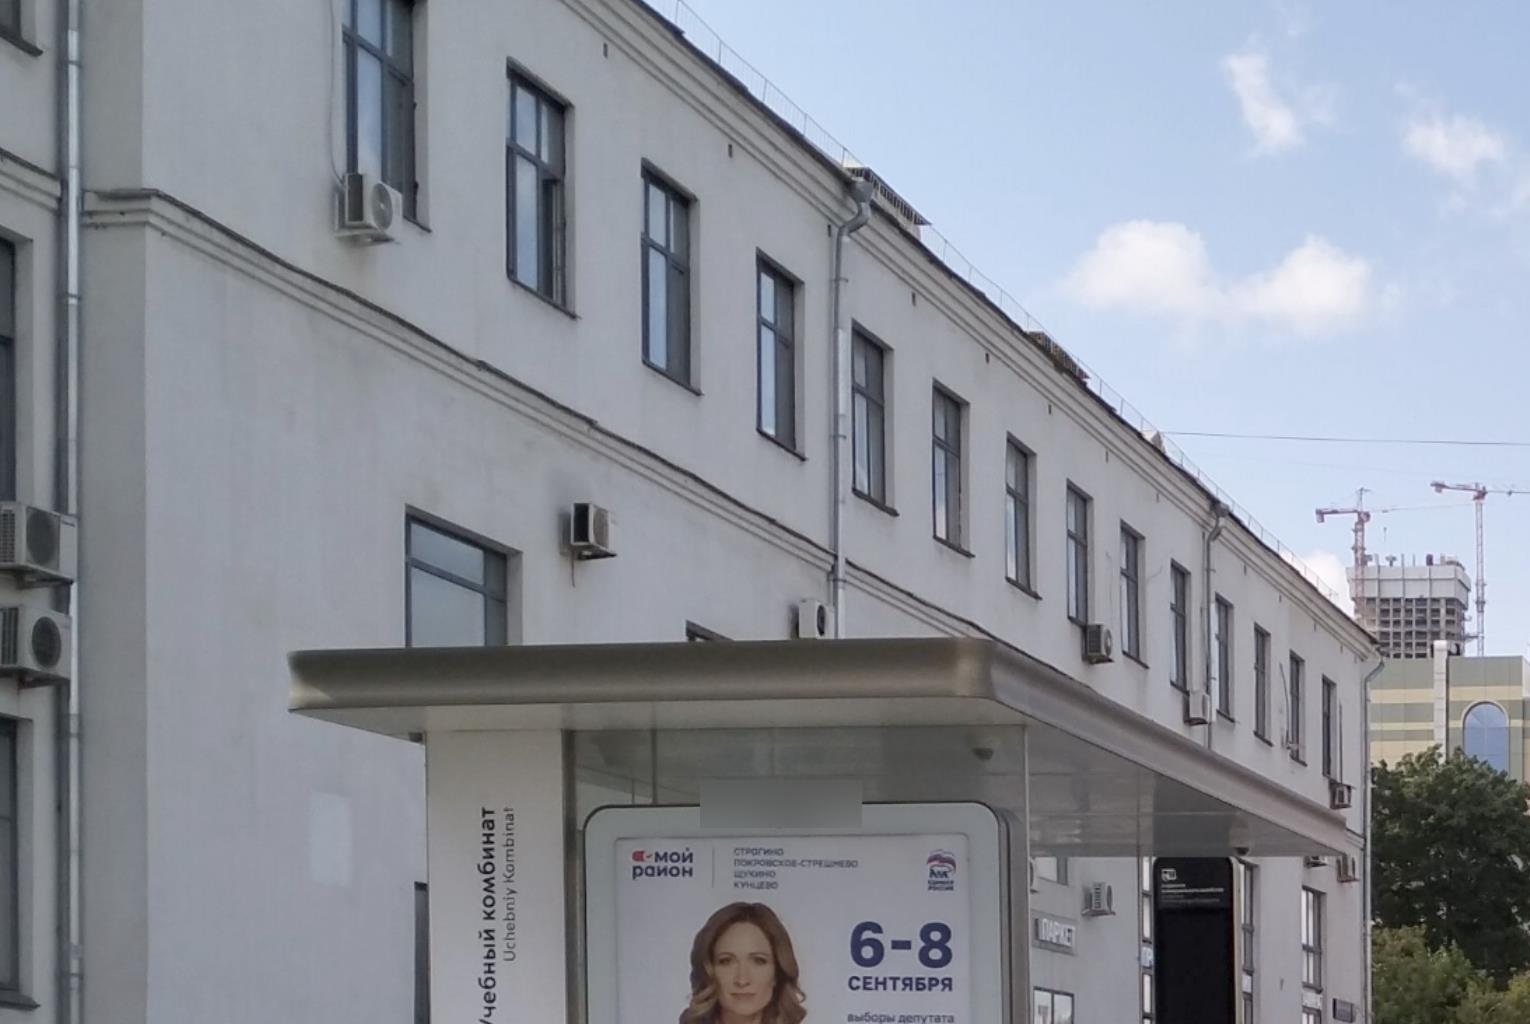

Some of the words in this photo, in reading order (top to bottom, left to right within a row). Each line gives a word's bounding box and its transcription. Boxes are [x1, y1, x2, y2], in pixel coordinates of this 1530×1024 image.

[503, 806, 516, 883] Kombinat
[734, 847, 784, 856] СТРОГИНО
[654, 847, 693, 863] мой
[477, 807, 496, 921] комбинат
[632, 865, 693, 880] район
[503, 888, 518, 962] Uchebniy
[848, 975, 953, 992] СЕНТЯБРЯ
[847, 1012, 895, 1024] выборы
[898, 1013, 955, 1024] депутата
